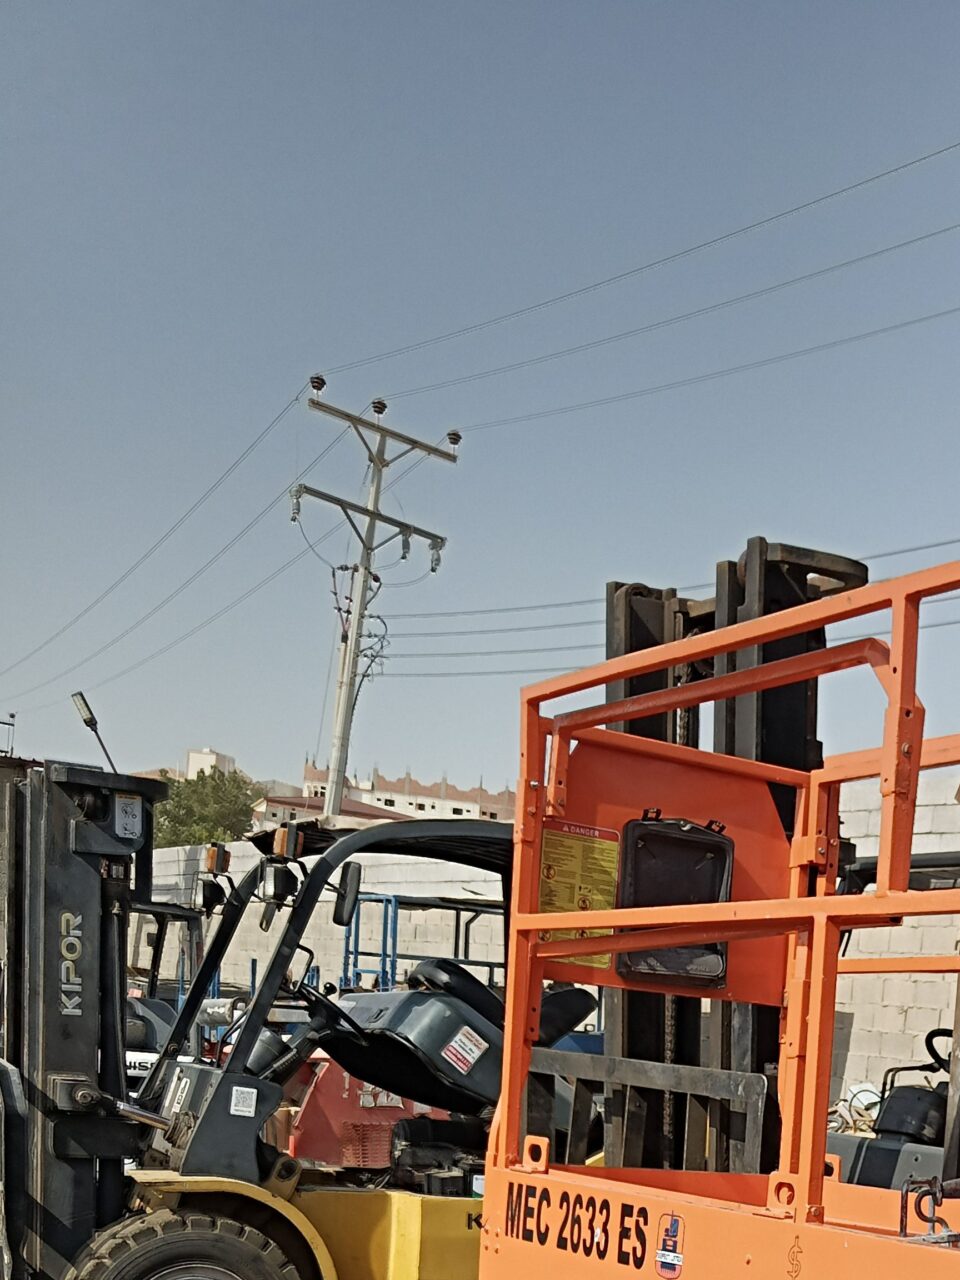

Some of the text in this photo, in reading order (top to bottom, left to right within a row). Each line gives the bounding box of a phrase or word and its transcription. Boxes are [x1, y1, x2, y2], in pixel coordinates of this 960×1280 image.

[570, 825, 600, 838] DANGER
[61, 911, 83, 1016] KIPOR
[505, 1181, 649, 1270] MEC 2633 ES
